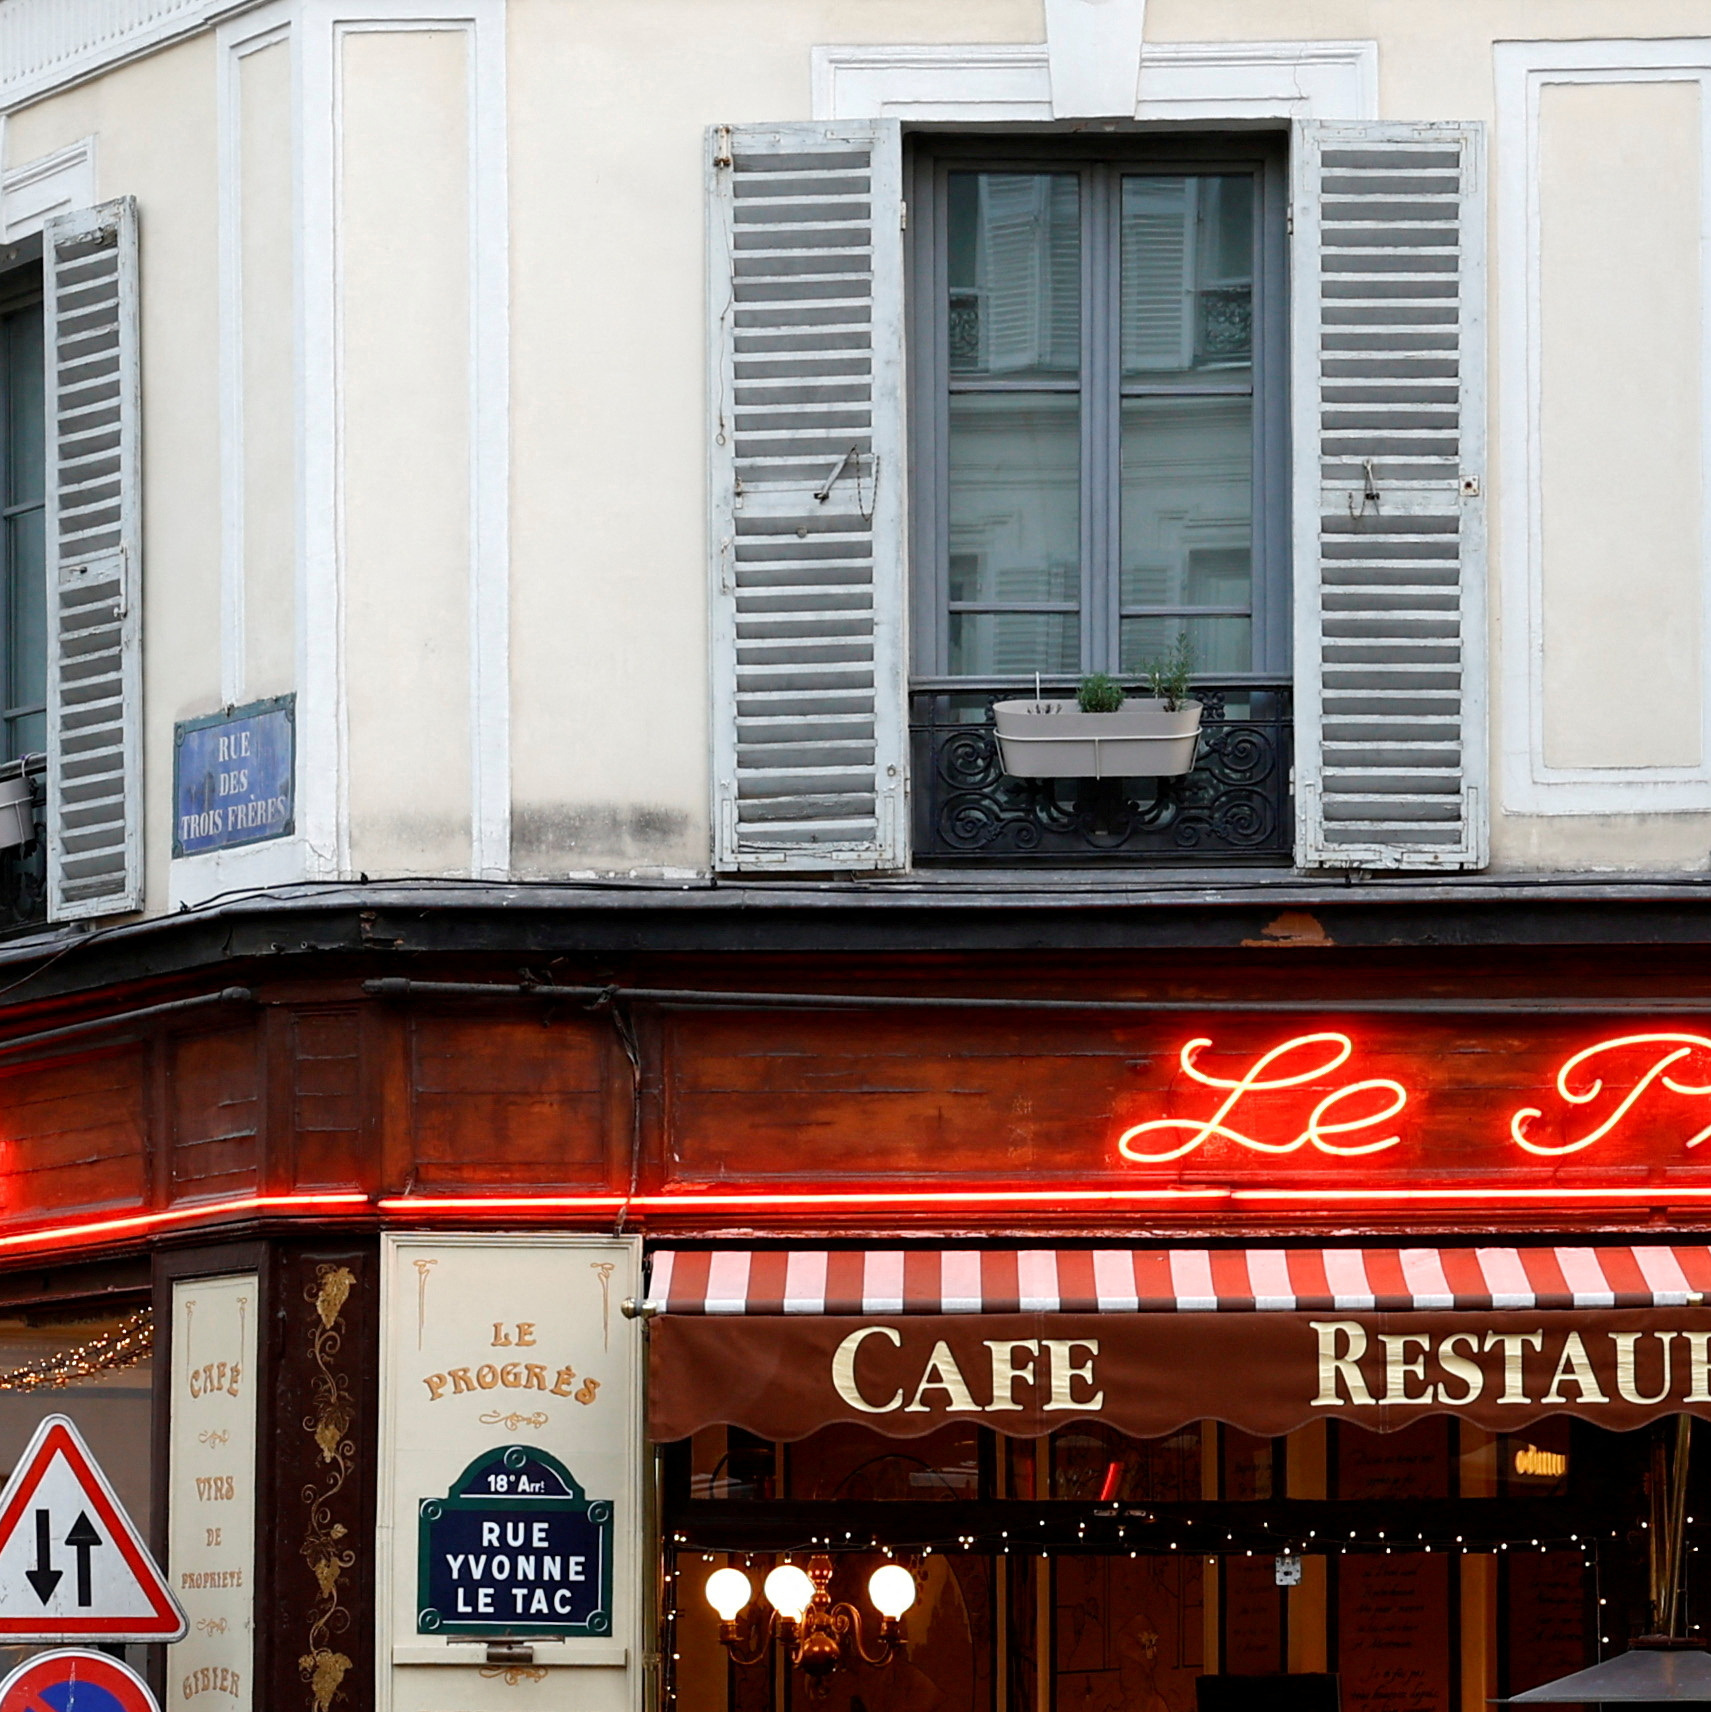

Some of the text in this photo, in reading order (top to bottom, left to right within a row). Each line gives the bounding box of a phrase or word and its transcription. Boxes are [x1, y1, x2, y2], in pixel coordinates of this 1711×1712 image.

[218, 731, 251, 762] RUE
[219, 768, 249, 796] DES
[181, 808, 224, 841] TROIS
[1117, 1031, 1408, 1164] Le
[490, 1321, 538, 1348] LE
[189, 1360, 242, 1399] CAFÉ
[829, 1325, 1106, 1414] CAFE
[422, 1361, 602, 1407] PROGRÈS
[195, 1475, 235, 1503] VINS
[205, 1527, 222, 1547] DE
[481, 1521, 550, 1549] RUE
[444, 1554, 586, 1582] YVONNE
[456, 1587, 573, 1615] LE TAC
